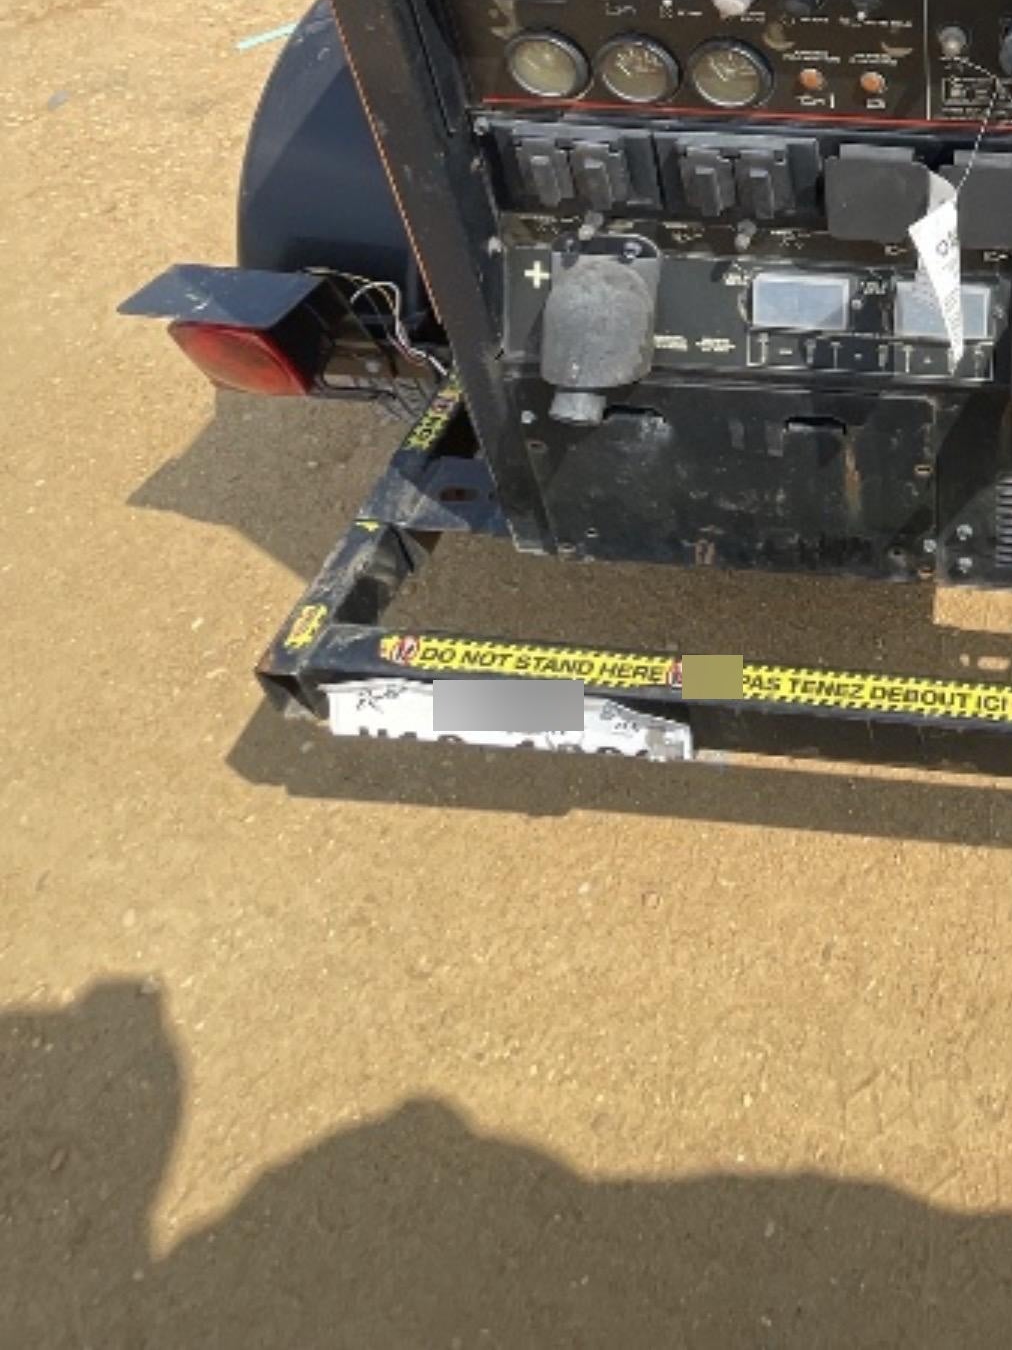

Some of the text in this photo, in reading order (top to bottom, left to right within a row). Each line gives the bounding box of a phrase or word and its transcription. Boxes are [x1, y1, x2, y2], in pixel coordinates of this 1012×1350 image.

[420, 646, 446, 663] DO
[463, 648, 512, 669] NOT
[515, 653, 595, 679] STAND
[598, 660, 665, 683] HERE
[975, 695, 1007, 713] ICI
